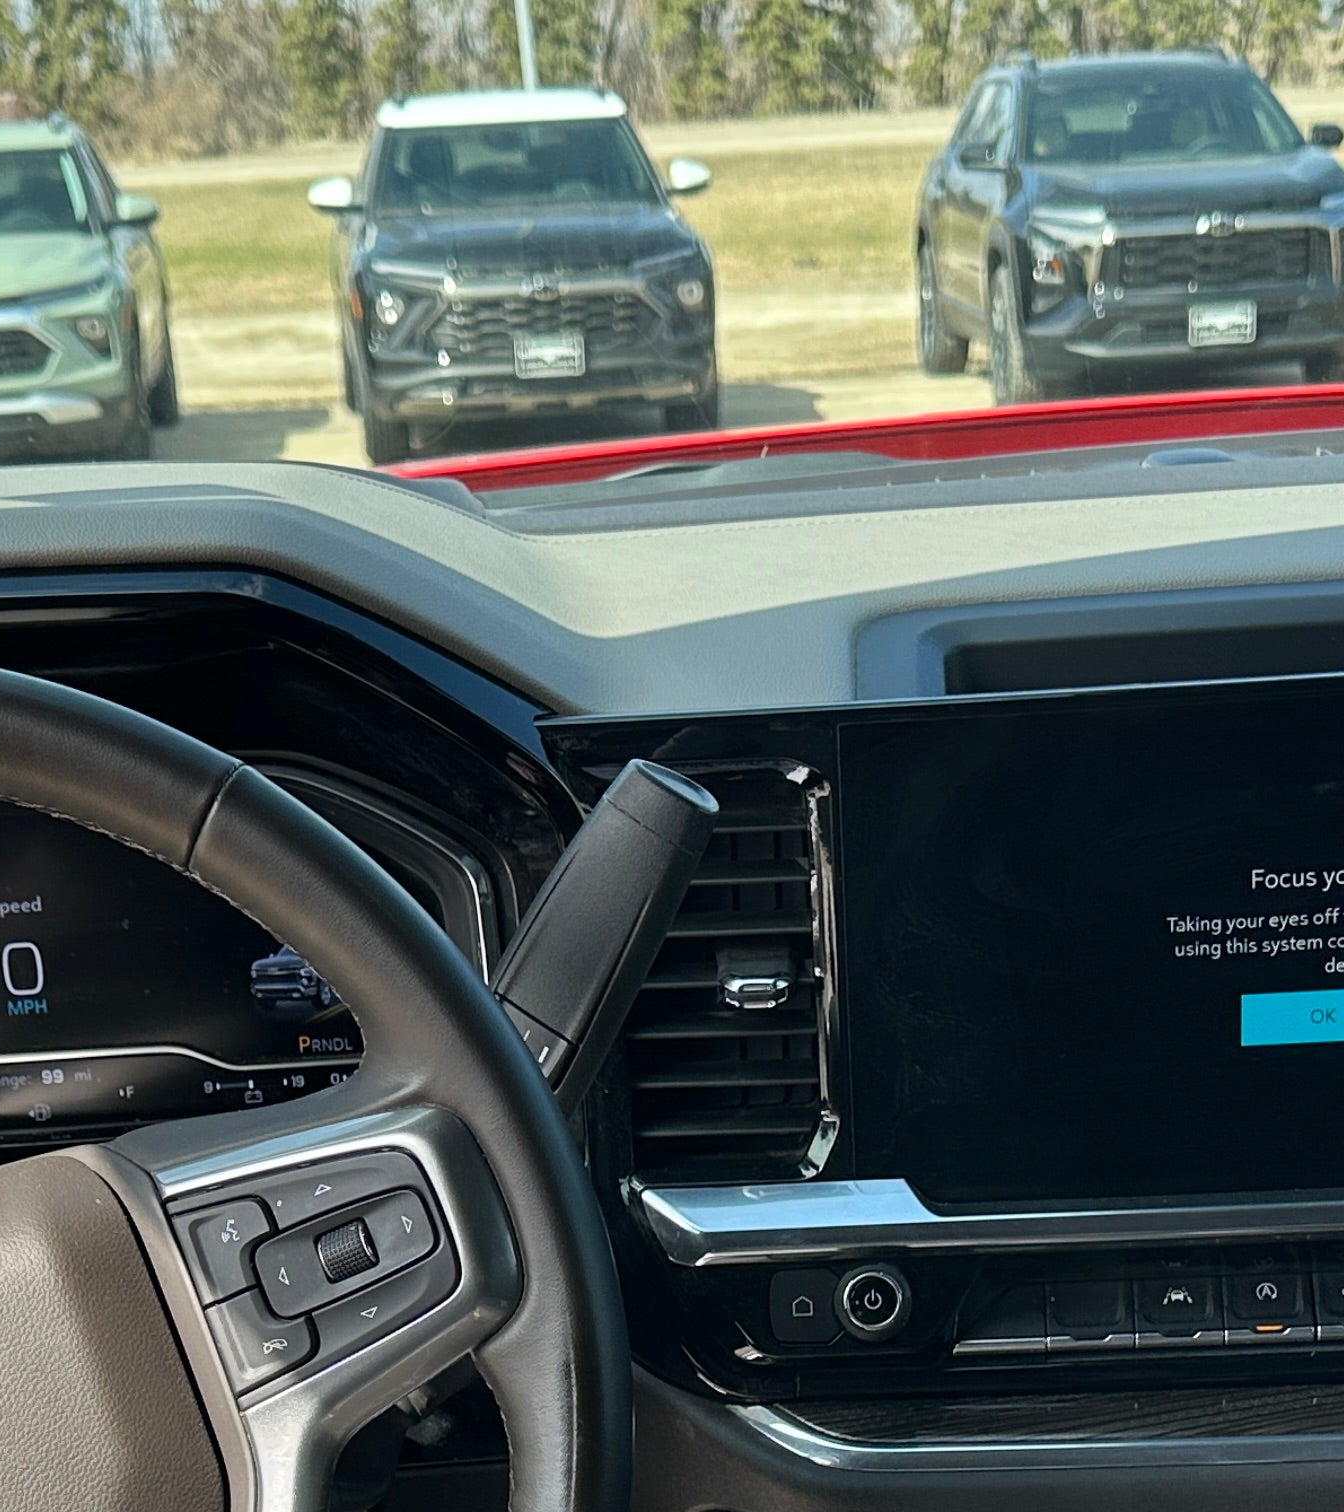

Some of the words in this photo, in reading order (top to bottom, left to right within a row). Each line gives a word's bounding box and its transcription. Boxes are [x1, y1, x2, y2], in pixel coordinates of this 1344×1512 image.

[1251, 868, 1318, 890] Focus
[1166, 915, 1222, 936] Taking
[1225, 917, 1265, 935] your
[1268, 914, 1309, 932] eyes
[1312, 907, 1339, 926] off
[1174, 940, 1222, 960] using
[1225, 936, 1258, 955] this
[1261, 935, 1324, 957] system
[1, 941, 45, 996] 0
[6, 998, 49, 1016] MPH
[1309, 1008, 1337, 1025] OK
[40, 1068, 65, 1085] 99
[73, 1068, 93, 1083] mi
[290, 1074, 305, 1088] 19
[125, 1085, 136, 1099] F
[203, 1080, 214, 1094] 9
